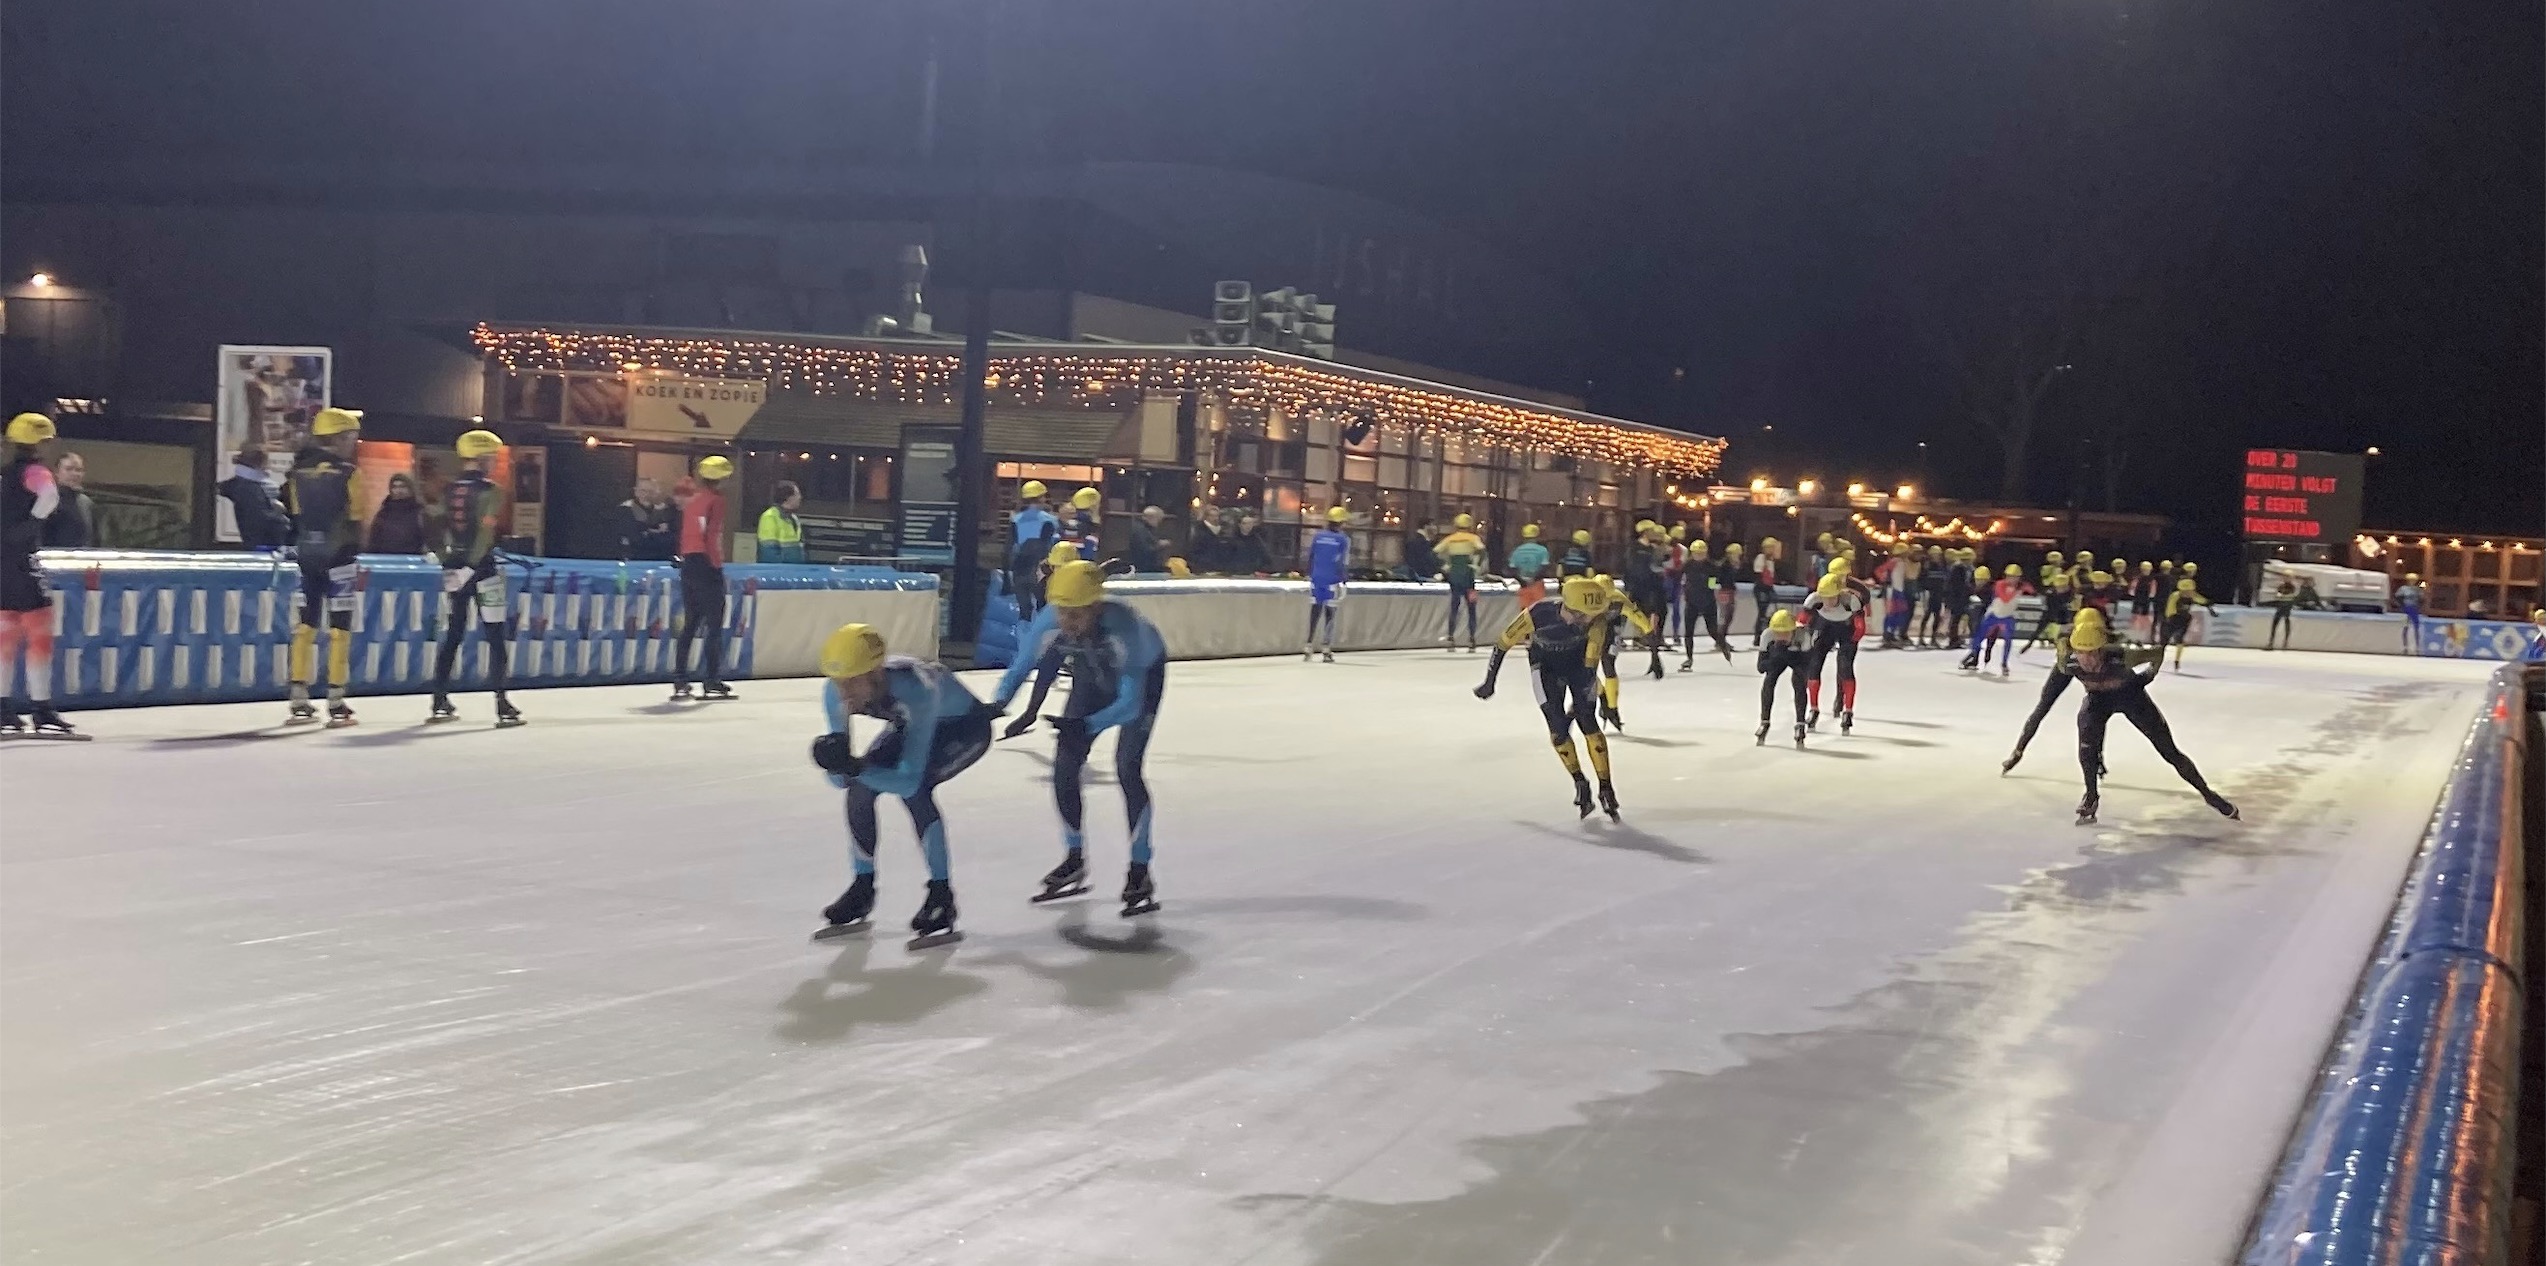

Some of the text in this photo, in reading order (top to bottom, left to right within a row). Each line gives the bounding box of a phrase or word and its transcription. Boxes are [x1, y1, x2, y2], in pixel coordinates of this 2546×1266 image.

[636, 385, 759, 403] KOEK EN ZOPIE
[2247, 451, 2277, 467] OVER
